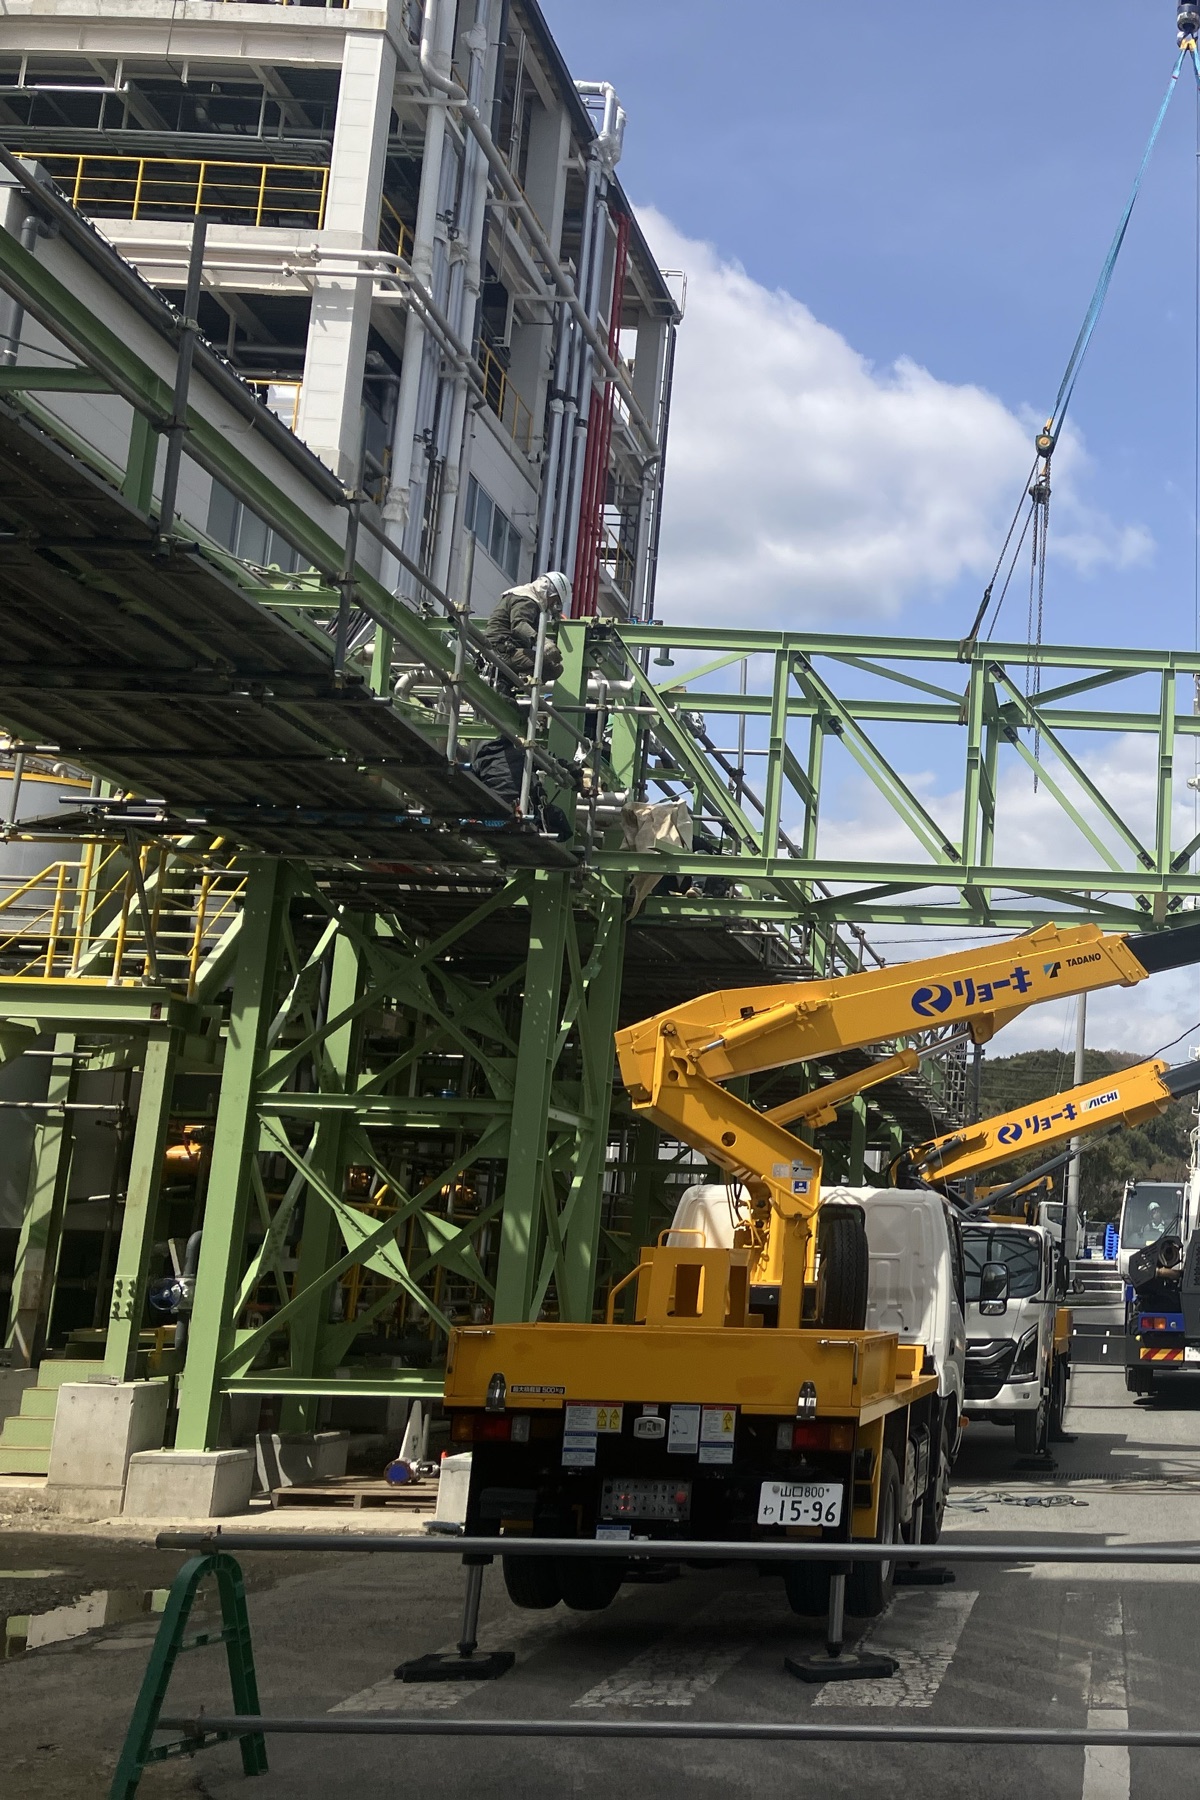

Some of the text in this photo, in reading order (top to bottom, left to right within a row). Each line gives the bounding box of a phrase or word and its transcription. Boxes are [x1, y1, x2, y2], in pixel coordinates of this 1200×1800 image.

[1066, 952, 1102, 968] TADANO
[953, 966, 1033, 1007] リョーキ
[1088, 1091, 1118, 1109] AICHI
[1024, 1102, 1078, 1135] リョーキ
[763, 1500, 837, 1523] わ 15-96
